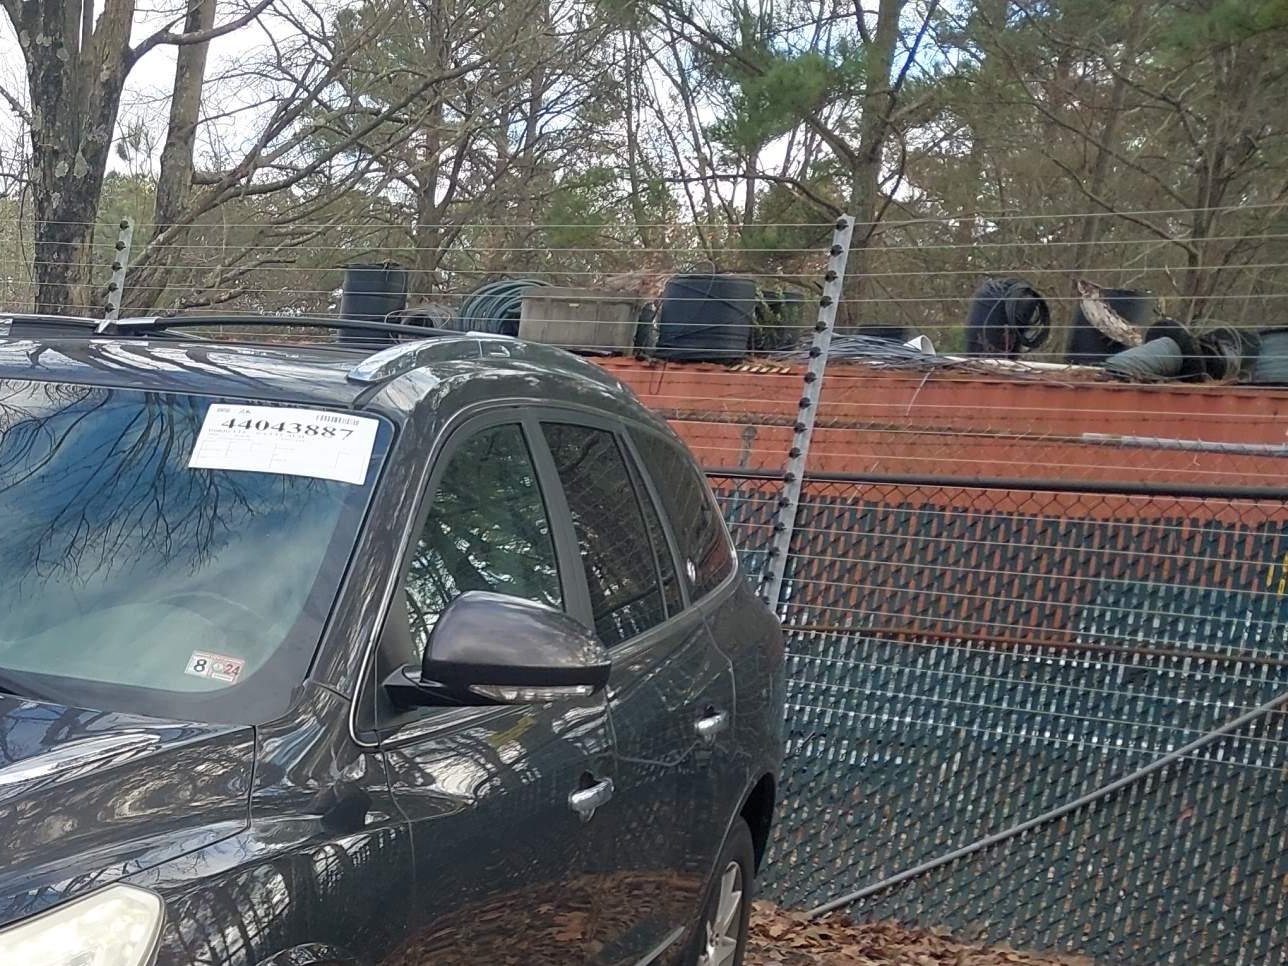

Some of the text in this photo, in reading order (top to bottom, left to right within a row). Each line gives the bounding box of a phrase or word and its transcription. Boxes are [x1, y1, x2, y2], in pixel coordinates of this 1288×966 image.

[221, 418, 354, 440] 44043887
[193, 659, 240, 676] 8 24
